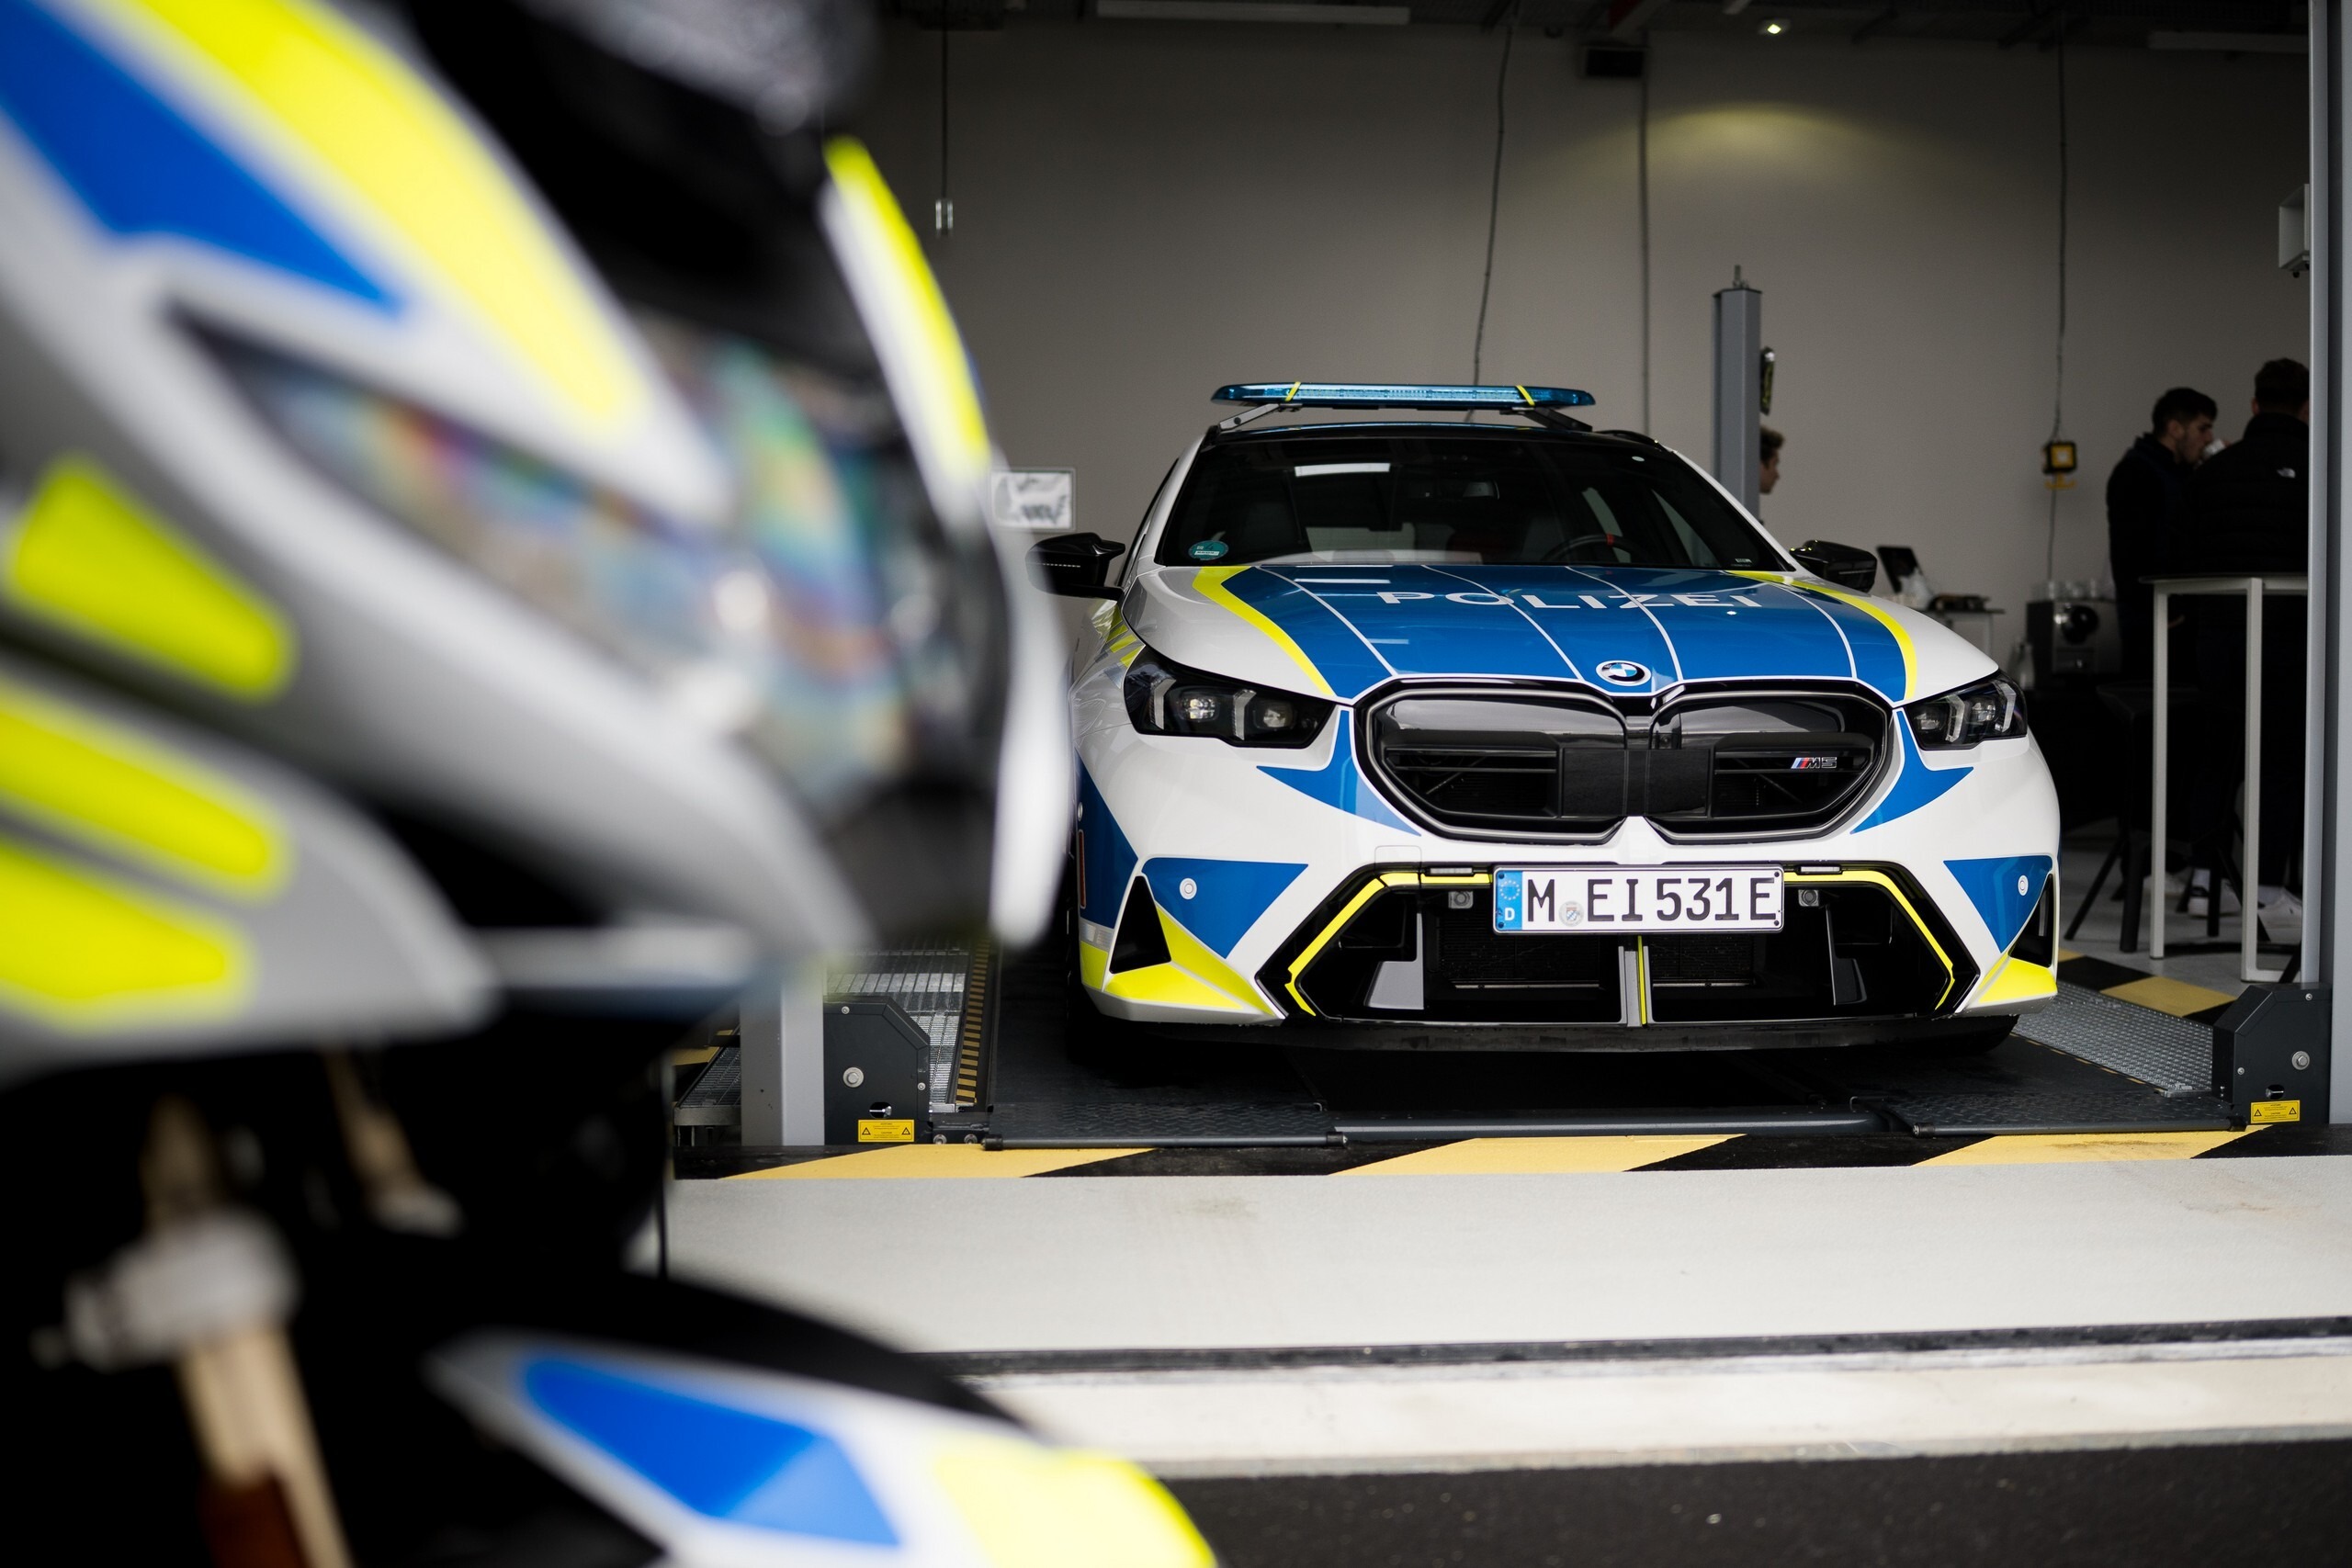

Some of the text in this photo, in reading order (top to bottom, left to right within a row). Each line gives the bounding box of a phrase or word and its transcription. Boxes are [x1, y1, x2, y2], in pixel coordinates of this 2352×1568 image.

[1376, 591, 1762, 609] POLIZEI
[1804, 757, 1838, 769] M5
[1527, 878, 1555, 922] M
[1504, 907, 1516, 921] D
